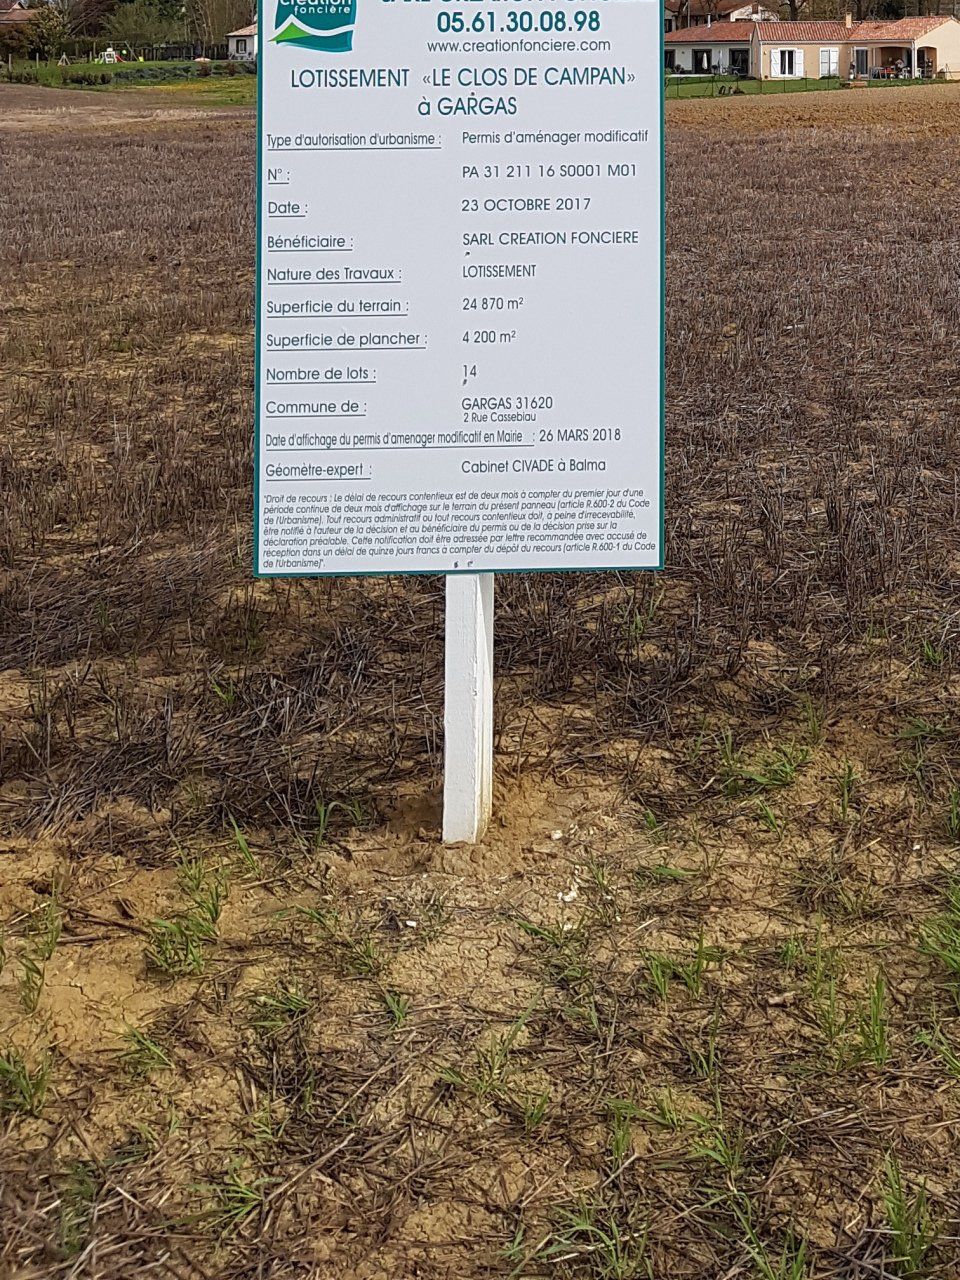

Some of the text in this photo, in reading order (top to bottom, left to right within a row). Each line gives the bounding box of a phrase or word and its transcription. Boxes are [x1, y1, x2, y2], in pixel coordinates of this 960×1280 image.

[294, 5, 351, 16] foncière
[437, 10, 600, 33] 05.61.30.08.98
[427, 38, 611, 52] www.creationfonciere.com
[291, 66, 635, 88] LOTISSEMENT «LE CLOS DE CAMPAN»
[418, 96, 517, 116] à GARGAS
[266, 132, 435, 148] Type d'autorisation d'urbanisme
[462, 130, 648, 146] Permis d'aménager modificatif
[463, 164, 636, 178] PA 31 211 16 S0001 M01
[268, 201, 300, 214] Date
[461, 198, 591, 212] 23 OCTOBRE 2017
[267, 235, 345, 249] Bénéficiaire
[463, 231, 638, 246] SARL CREATION FONCIERE
[267, 267, 394, 281] Nature des Travaux
[463, 264, 536, 278] LOTISSEMENT
[267, 299, 401, 316] Superficie du terrain
[463, 297, 524, 311] 24 870 m²
[266, 366, 368, 381] Nombre de lots
[463, 364, 477, 377] 14
[265, 400, 359, 414] Commune de
[461, 396, 553, 410] GARGAS 31620
[266, 428, 621, 448] Date d'affichage du permis d'amenager modificatif en Mairie 26 MARS 2018
[265, 462, 363, 477] Géomètre-expert
[461, 458, 606, 473] Cabinet CIVADE à Balma
